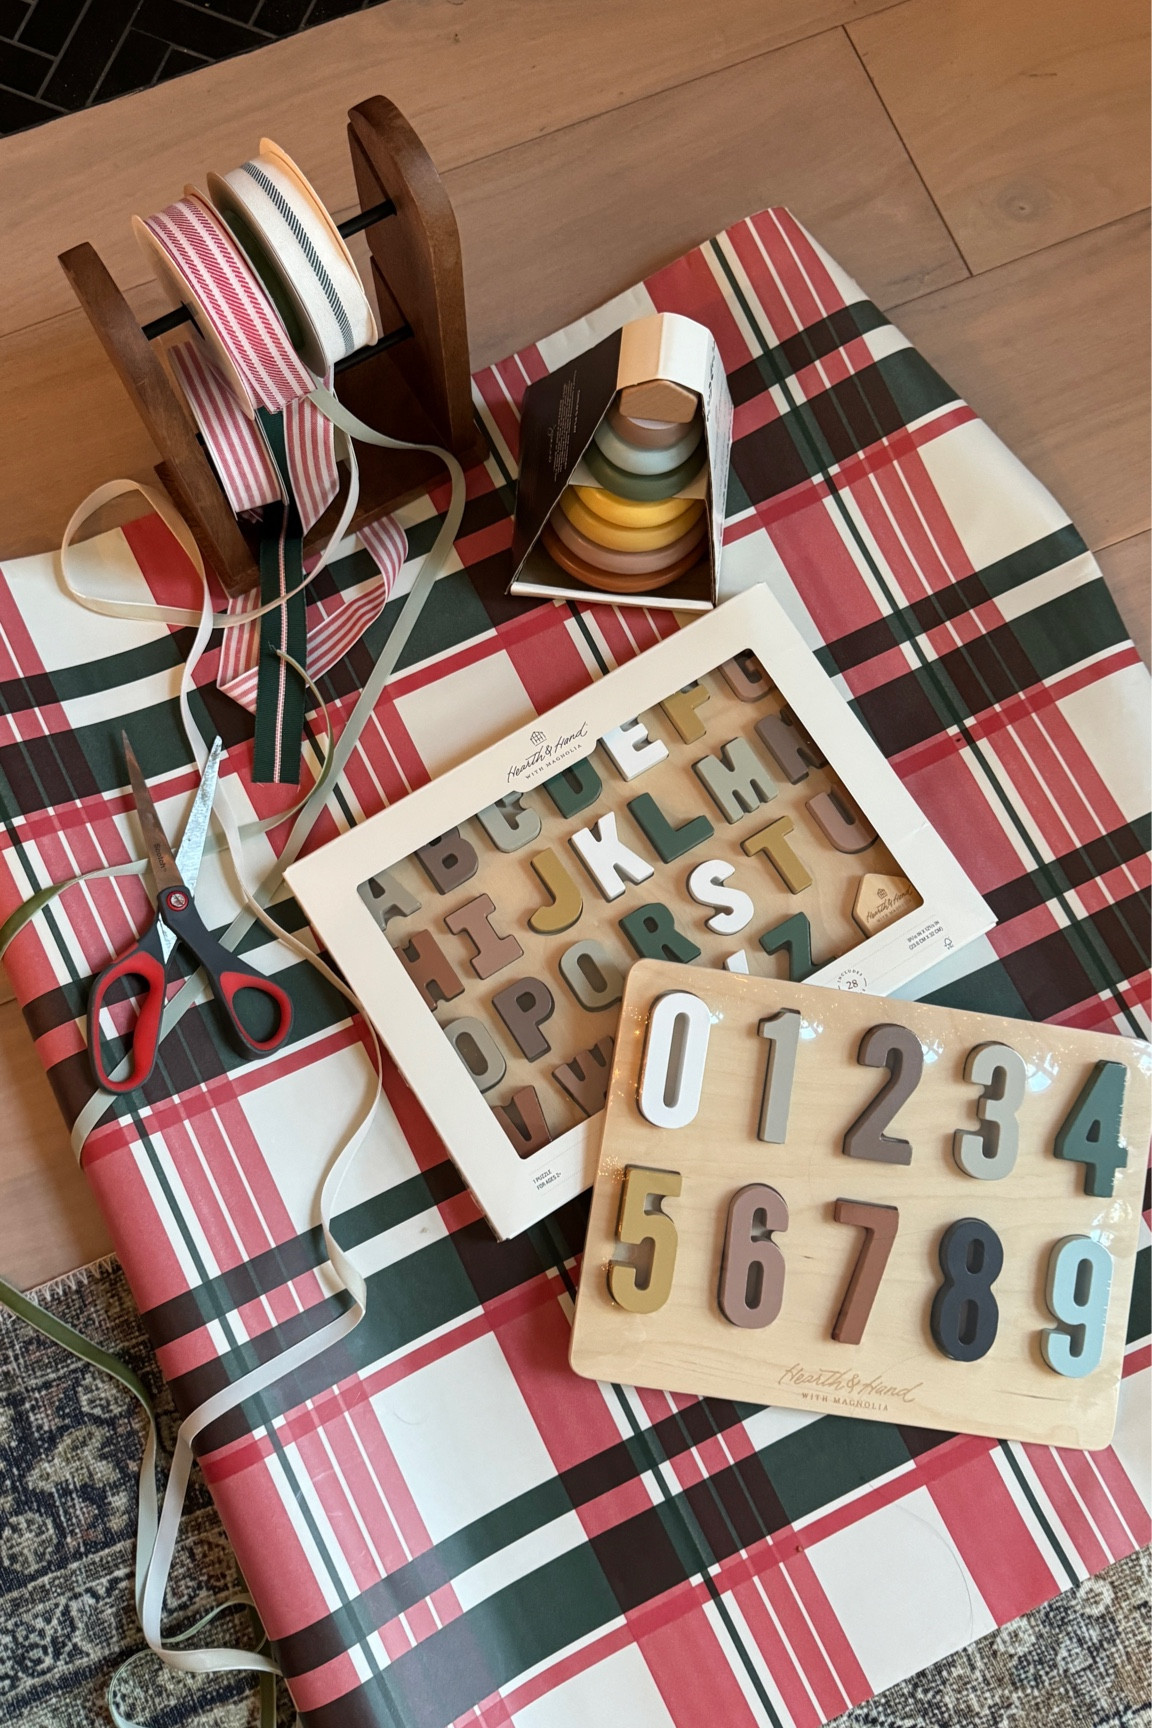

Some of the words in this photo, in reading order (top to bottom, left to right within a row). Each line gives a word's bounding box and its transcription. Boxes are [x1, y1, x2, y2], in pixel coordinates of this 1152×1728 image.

[507, 745, 546, 783] Hearth
[545, 744, 552, 757] &
[555, 721, 588, 754] Hand
[525, 767, 544, 780] WITH
[545, 744, 582, 767] MAGNOLIA
[414, 826, 479, 896] B
[598, 718, 670, 782] E
[154, 843, 166, 869] Scotch
[444, 892, 525, 980] I
[527, 847, 583, 936] J
[567, 811, 655, 904] K
[627, 792, 715, 865] L
[691, 737, 779, 825] M
[492, 977, 556, 1063] P
[618, 902, 702, 964] R
[686, 860, 755, 936] S
[740, 815, 812, 895] T
[846, 979, 858, 990] 28
[636, 989, 713, 1130] 0
[757, 1007, 802, 1145] 1
[842, 1022, 924, 1166] 2
[953, 1040, 1027, 1181] 3
[1054, 1059, 1128, 1198] 4
[535, 1169, 552, 1182] PUZZLE
[536, 1181, 546, 1190] FOR
[545, 1174, 557, 1184] AGES
[607, 1164, 683, 1315] 5
[716, 1182, 790, 1330] 6
[831, 1197, 900, 1345] 7
[931, 1216, 1004, 1362] 8
[1041, 1233, 1114, 1379] 9
[778, 1363, 852, 1391] Hearth
[846, 1373, 861, 1394] &
[857, 1375, 924, 1403] Hand
[801, 1392, 829, 1403] WITH
[833, 1397, 889, 1411] MAGNOLIA
